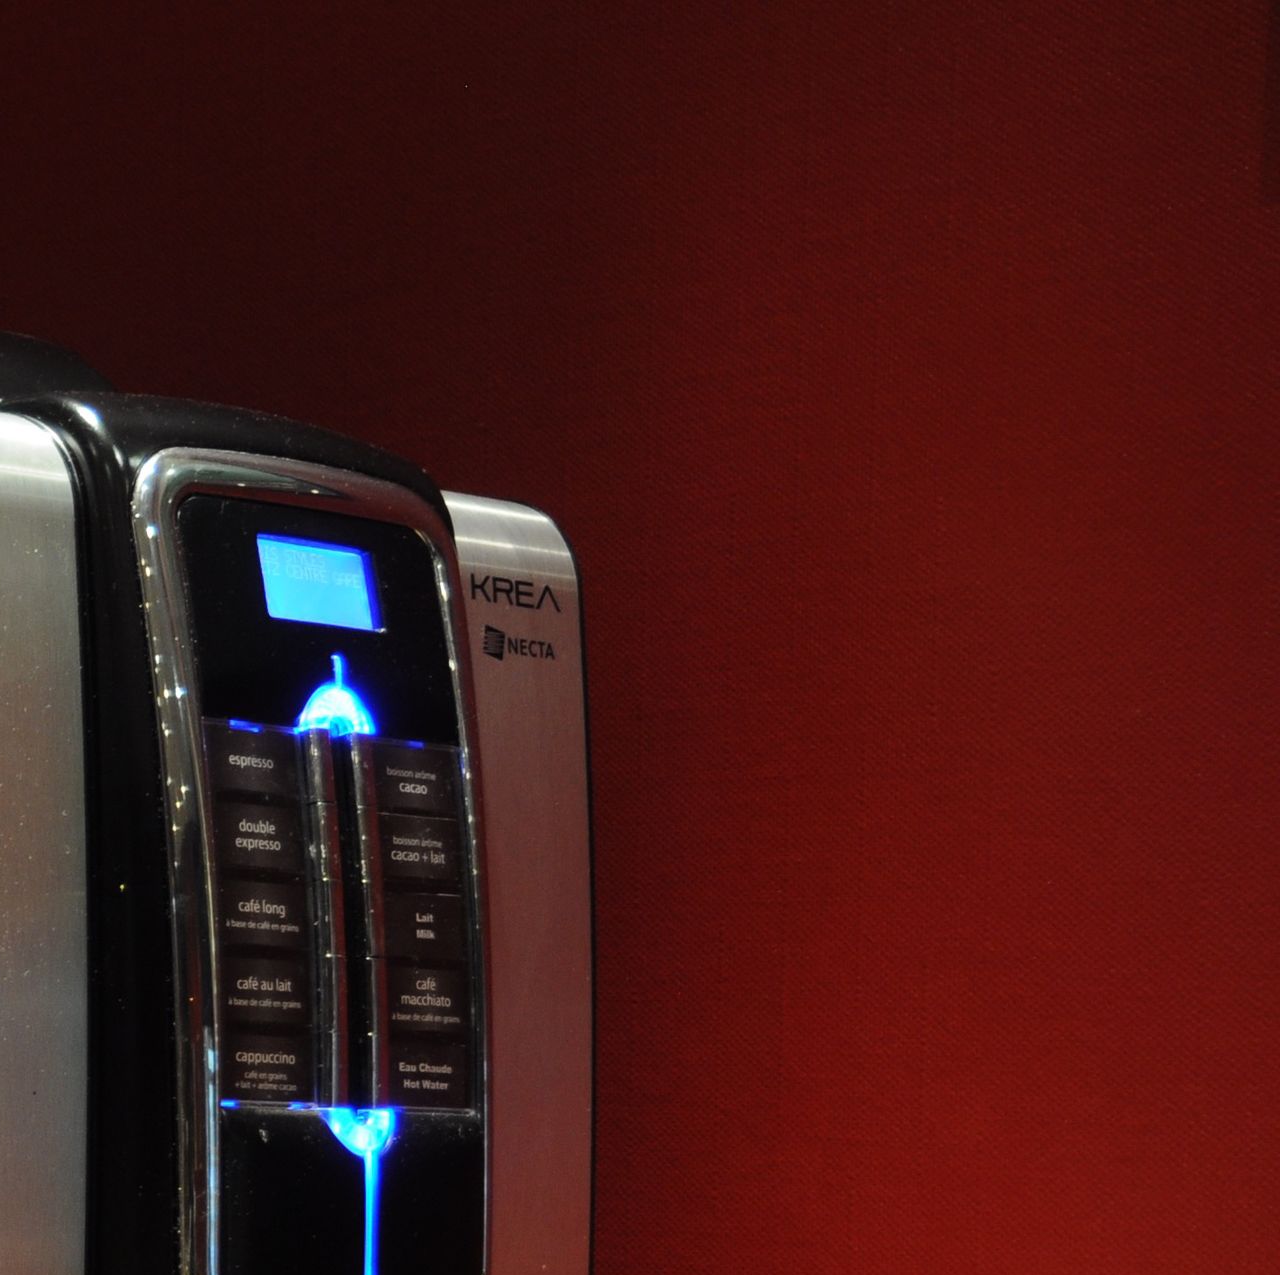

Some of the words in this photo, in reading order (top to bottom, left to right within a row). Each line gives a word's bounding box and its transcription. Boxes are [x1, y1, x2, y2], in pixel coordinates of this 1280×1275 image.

[470, 573, 561, 613] KREA
[507, 637, 555, 660] NECTA
[229, 755, 274, 769] espresso
[399, 782, 428, 795] cacao
[239, 818, 276, 835] double
[391, 850, 420, 862] cacao
[430, 850, 446, 865] lait
[238, 899, 260, 913] café
[262, 899, 286, 918] long
[416, 912, 434, 923] Lait
[236, 976, 258, 990] café
[260, 980, 273, 991] au
[275, 978, 292, 992] lait
[416, 976, 436, 991] café
[401, 993, 451, 1007] macchiato
[235, 1051, 295, 1066] cappuccino
[399, 1062, 417, 1072] Eau
[419, 1063, 452, 1074] Chaude
[403, 1079, 419, 1089] Hot
[422, 1079, 449, 1090] Water
